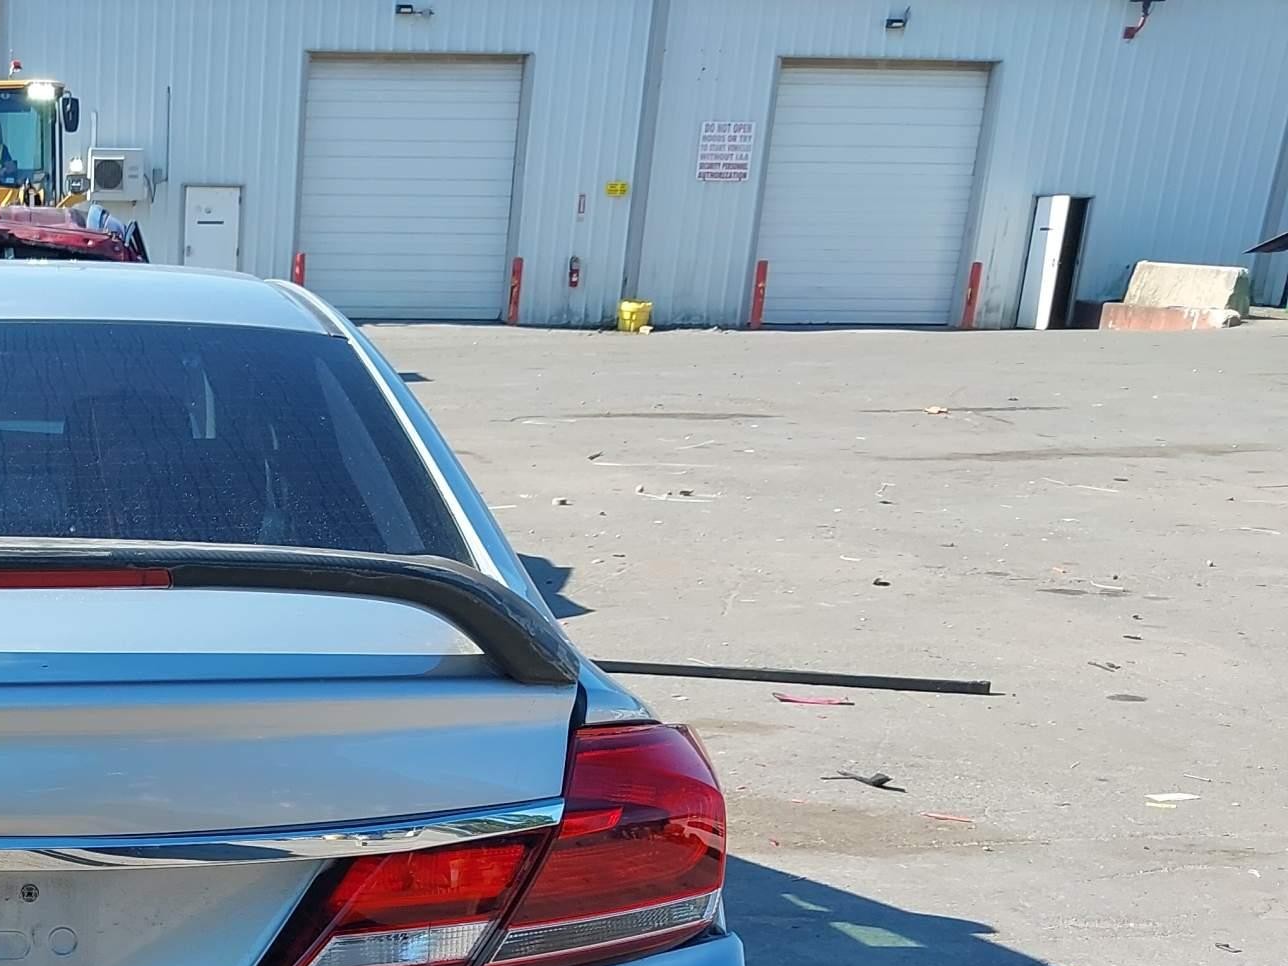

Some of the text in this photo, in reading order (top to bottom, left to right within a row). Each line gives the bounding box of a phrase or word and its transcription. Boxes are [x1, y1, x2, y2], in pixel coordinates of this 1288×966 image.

[705, 123, 753, 133] DO NOT OPEN
[700, 153, 734, 161] WITHOUT
